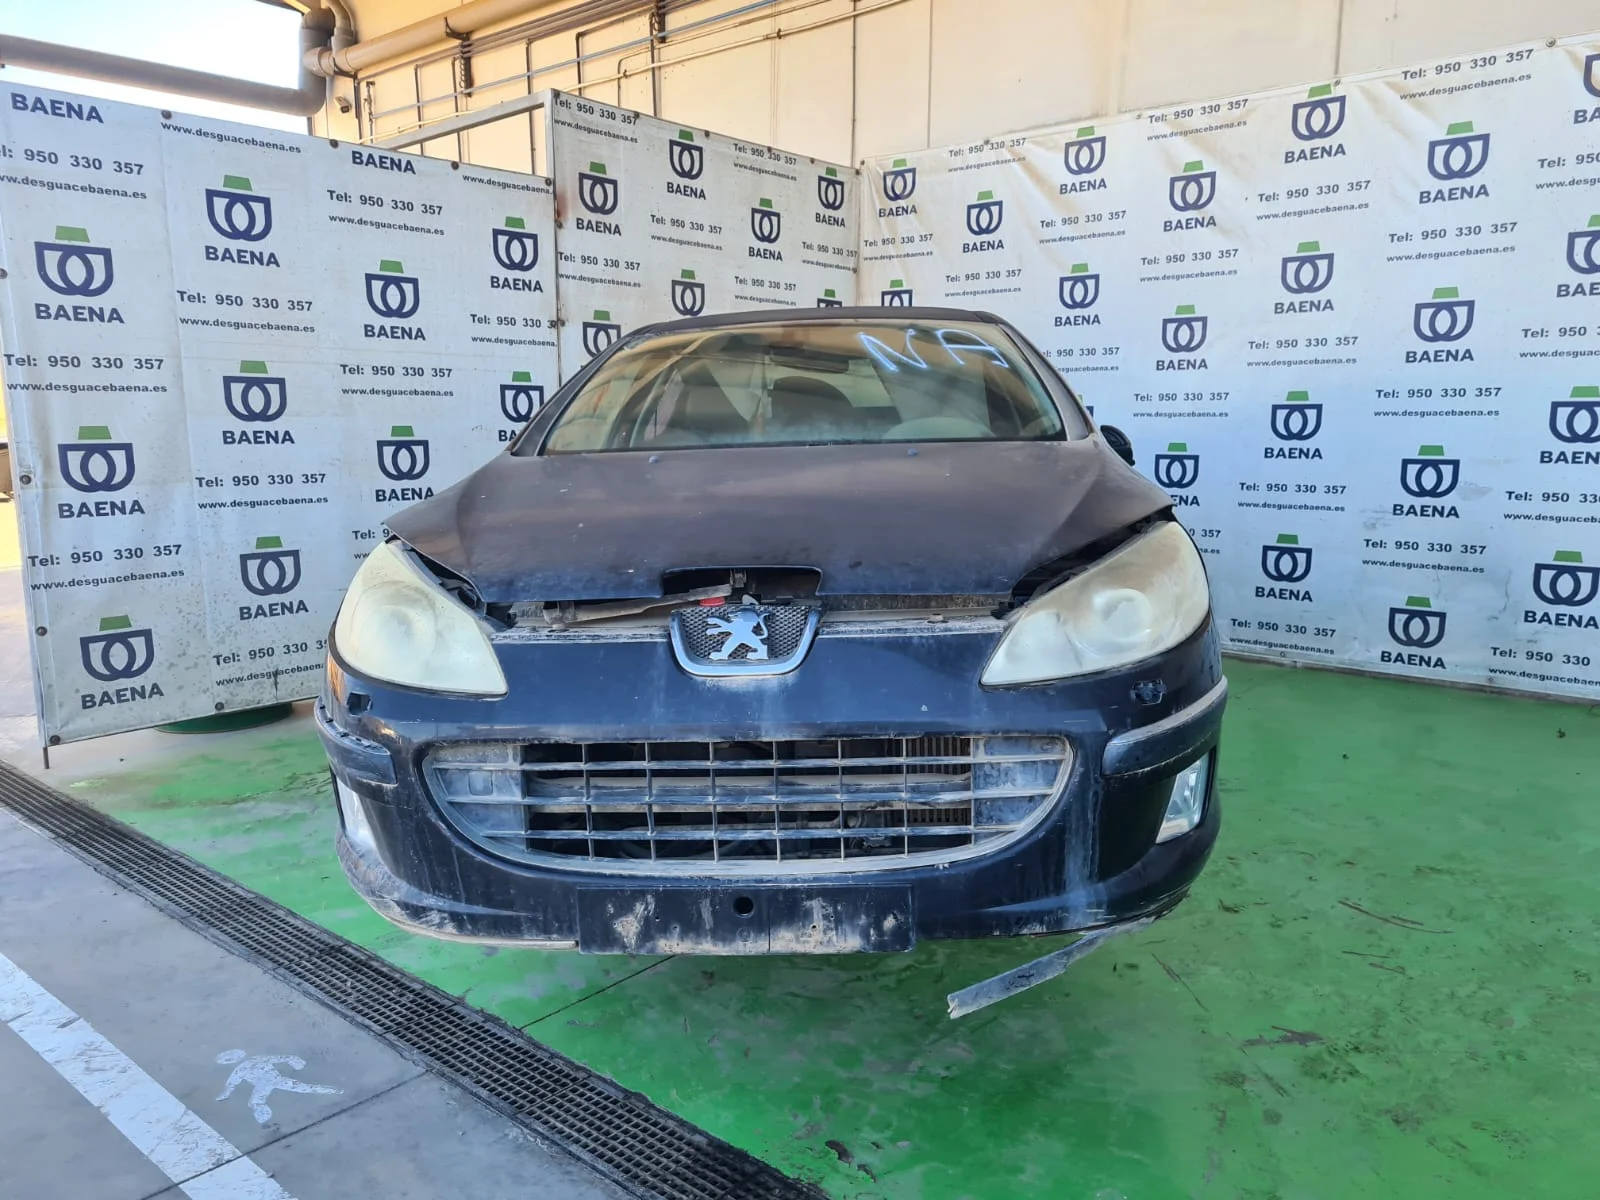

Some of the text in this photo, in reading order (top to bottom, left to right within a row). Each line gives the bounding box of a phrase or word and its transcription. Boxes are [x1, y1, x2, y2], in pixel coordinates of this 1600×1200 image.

[1402, 49, 1534, 80] Tel: 950 330 357
[1400, 74, 1531, 100] www.desguacebaena.es
[11, 92, 104, 123] BAENA
[577, 102, 594, 115] 950
[600, 108, 616, 121] 330
[621, 113, 638, 125] 357
[1148, 99, 1248, 124] Tel: 950 330 357
[161, 122, 301, 153] www.desguacebaena.es
[1147, 121, 1246, 140] www.desguacebaena.es
[1284, 143, 1346, 164] BAENA
[1538, 152, 1600, 168] Tel: 950
[24, 149, 58, 164] 950
[70, 155, 102, 170] 330
[113, 161, 143, 175] 357
[352, 150, 416, 175] BAENA
[667, 182, 706, 200] BAENA
[1059, 178, 1107, 195] BAENA
[1258, 180, 1371, 202] Tel: 950 330 357
[1419, 184, 1489, 204] BAENA
[327, 190, 442, 215] Tel: 950 330 357
[879, 204, 917, 218] BAENA
[1040, 210, 1126, 228] Tel: 950 330 357
[1257, 203, 1368, 220] www.desguacebaena.es
[329, 216, 444, 235] www.desguacebaena.es
[576, 217, 621, 236] BAENA
[650, 214, 722, 235] Tel: 950 330 357
[816, 212, 845, 228] BAENA
[1164, 216, 1216, 232] BAENA
[1389, 222, 1517, 243] Tel: 950 330 357
[749, 246, 783, 261] BAENA
[963, 239, 1004, 253] BAENA
[1387, 246, 1515, 261] www.desguacebaena.es
[205, 245, 280, 267] BAENA
[557, 251, 640, 271] Tel: 950 330 357
[1141, 249, 1238, 265] Tel: 950 330 357
[1140, 270, 1237, 282] www.desguacebaena.es
[490, 276, 543, 293] BAENA
[1556, 282, 1600, 297] BAE
[177, 290, 312, 311] Tel: 950 330 357
[1274, 299, 1334, 314] BAENA
[35, 303, 125, 324] BAENA
[470, 314, 490, 324] Tel:
[497, 316, 516, 326] 950
[523, 318, 541, 328] 330
[1055, 314, 1101, 327] BAENA
[180, 317, 315, 332] www.desguacebaena.es
[364, 324, 426, 341] BAENA
[1522, 327, 1587, 338] Tel: 950
[1248, 336, 1358, 349] Tel: 950 330 357
[3, 354, 163, 370] Tel: 950 330 357
[1247, 358, 1356, 367] www.desguacebaena.es
[1405, 349, 1474, 363] BAENA
[340, 364, 452, 378] Tel: 950 330 357
[1156, 358, 1208, 371] BAENA
[7, 382, 167, 393] www.desguacebaena.es
[342, 387, 453, 397] www.desguacebaena.es
[1376, 387, 1502, 398] Tel: 950 330 357
[1158, 393, 1177, 401] 950
[1184, 393, 1203, 401] 330
[1210, 392, 1229, 400] 357
[1374, 409, 1499, 418] www.desguacebaena.es
[222, 430, 295, 445] BAENA
[1264, 447, 1323, 459] BAENA
[1540, 451, 1600, 464] BAEN
[195, 473, 326, 488] Tel: 950 330 357
[1239, 482, 1346, 494] Tel: 950 330 357
[375, 487, 434, 502] BAENA
[1506, 491, 1532, 501] Tel:
[1542, 492, 1569, 502] 950
[58, 500, 145, 518] BAENA
[198, 497, 328, 509] www.desguacebaena.es
[1238, 501, 1345, 511] www.desguacebaena.es
[1392, 504, 1459, 518] BAENA
[1364, 539, 1486, 555] Tel: 950 330 357
[28, 544, 182, 568] Tel: 950 330 357
[1362, 560, 1484, 573] www.desguacebaena.es
[31, 570, 184, 591] www.desguacebaena.es
[1255, 586, 1313, 602] BAENA
[239, 600, 309, 620] BAENA
[1524, 610, 1599, 629] BAENA
[1231, 618, 1336, 638] Tel: 950 330 357
[213, 652, 240, 666] Tel:
[249, 647, 274, 660] 950
[283, 642, 308, 655] 330
[1229, 638, 1334, 654] www.desguacebaena.es
[1381, 651, 1446, 669] BAENA
[1491, 647, 1590, 666] Tel: 950 330
[81, 683, 164, 710] BAENA
